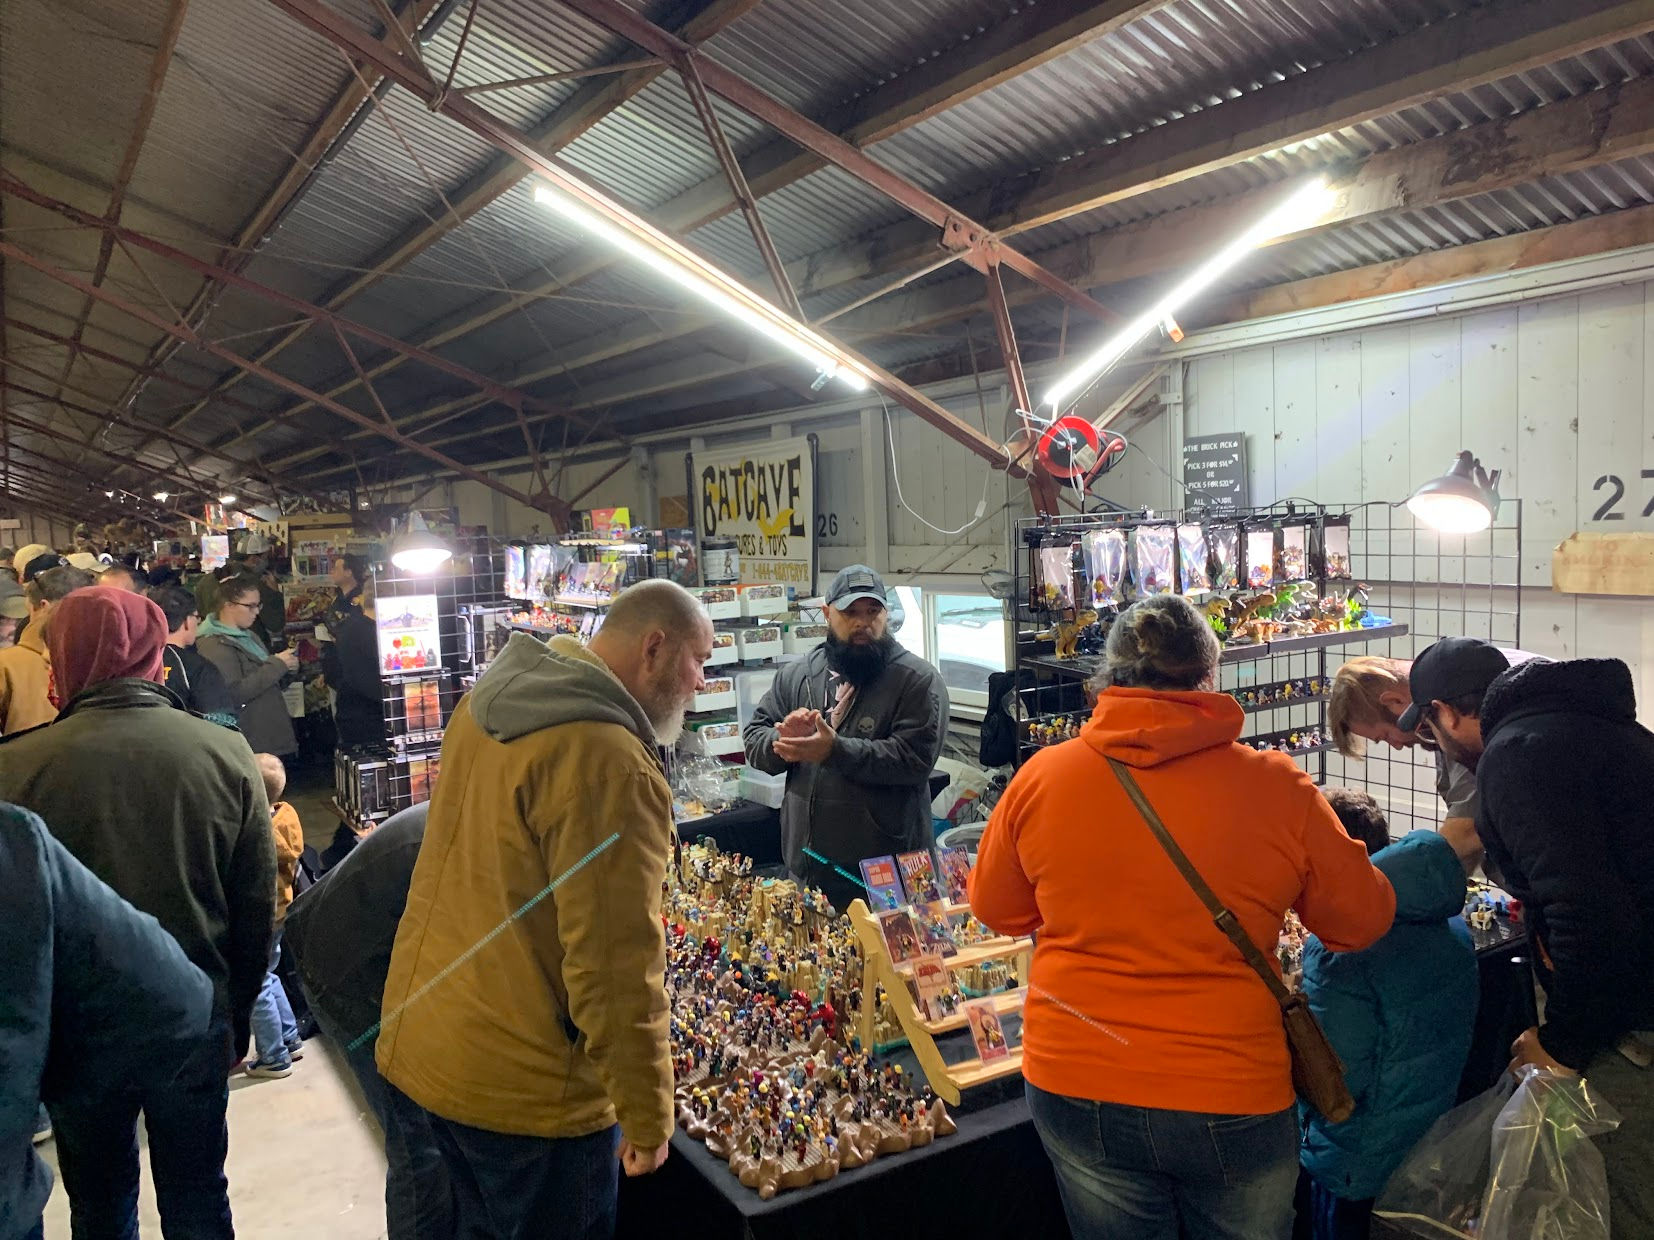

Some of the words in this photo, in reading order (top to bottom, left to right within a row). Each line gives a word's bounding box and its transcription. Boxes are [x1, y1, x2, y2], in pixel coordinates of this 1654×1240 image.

[1201, 442, 1218, 451] BRICK
[1220, 441, 1233, 449] PICK
[1187, 462, 1201, 470] PICK
[1206, 461, 1218, 469] FOR
[1188, 481, 1201, 489] PICK
[1207, 480, 1219, 488] FOR
[702, 455, 805, 537] BATCAVE
[1193, 497, 1205, 506] ALL
[817, 512, 838, 537] 26
[735, 533, 756, 556] URES
[767, 533, 788, 557] TOYS
[906, 855, 929, 877] HULK
